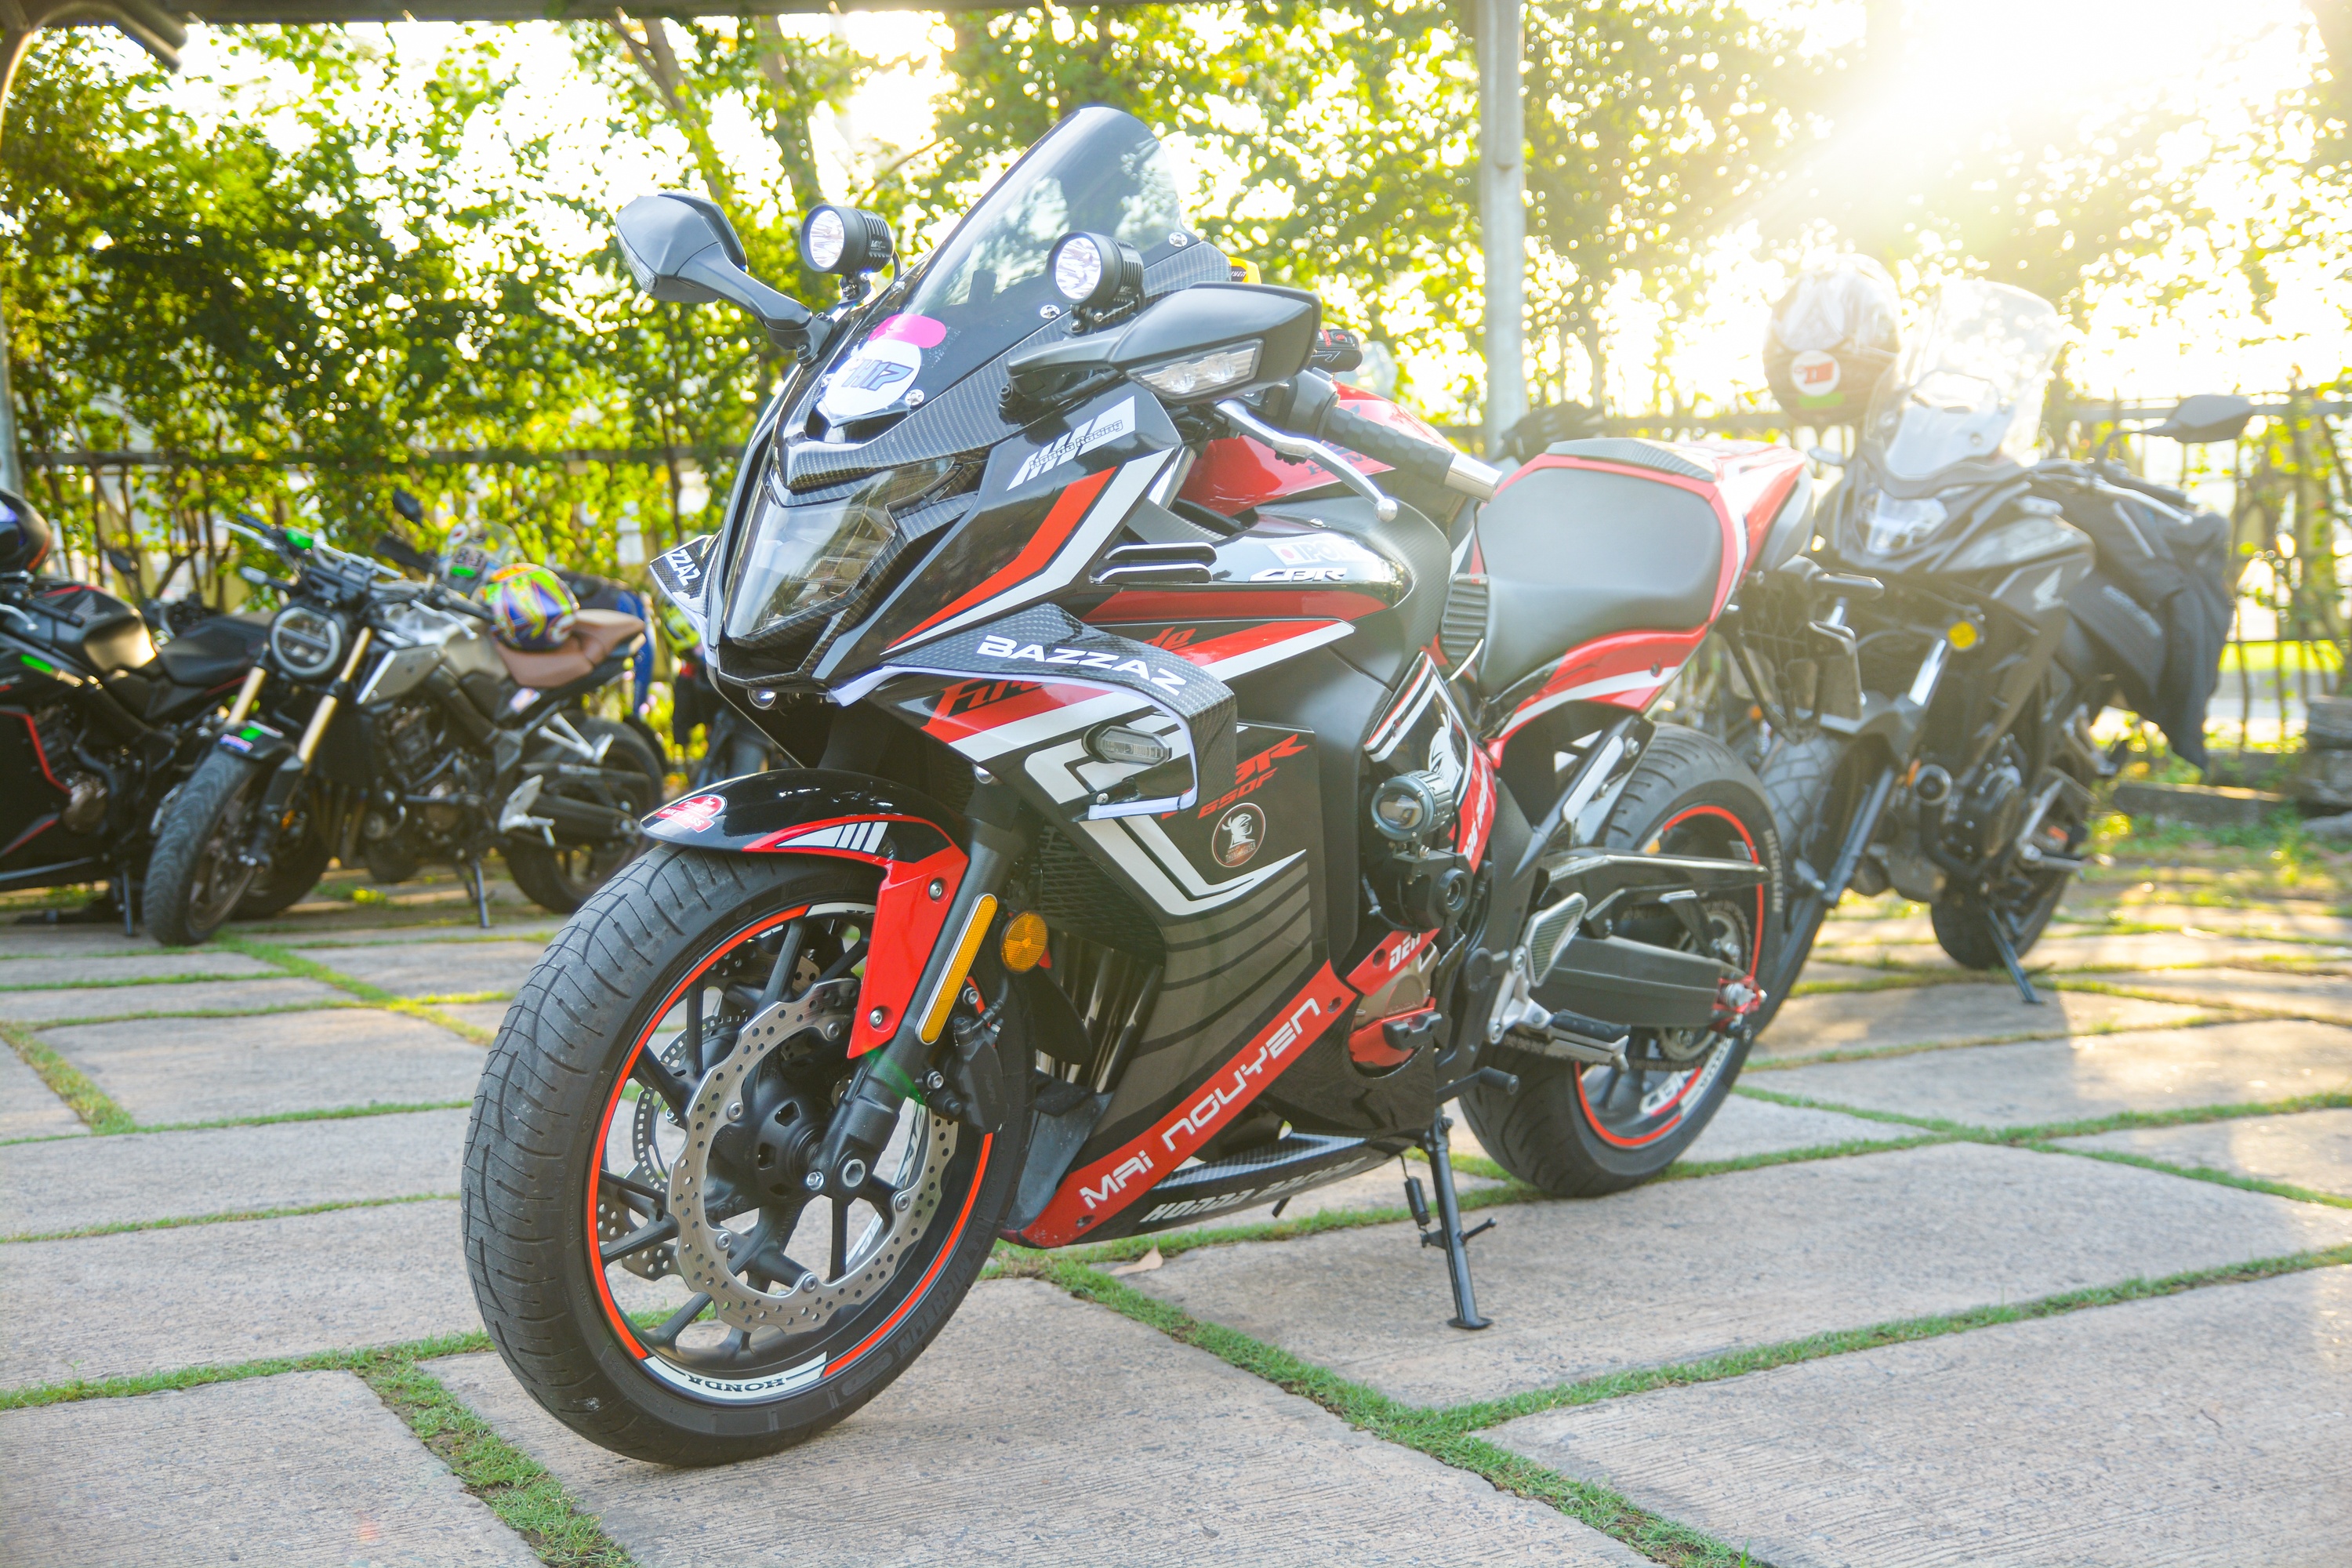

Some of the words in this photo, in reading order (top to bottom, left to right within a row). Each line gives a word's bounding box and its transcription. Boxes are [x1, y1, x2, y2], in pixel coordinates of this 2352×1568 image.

[841, 358, 914, 391] H17
[1029, 441, 1076, 470] Honda
[1076, 419, 1123, 448] Racing
[1248, 567, 1348, 583] CBR
[976, 635, 1187, 696] BAZZAZ
[1235, 733, 1308, 785] BR
[1197, 767, 1279, 819] 650F
[679, 812, 705, 827] PASS
[1764, 829, 1784, 912] MICHELIN
[1139, 1189, 1256, 1223] HONDA
[1252, 1156, 1367, 1200] RACING
[688, 1374, 786, 1392] HONDA
